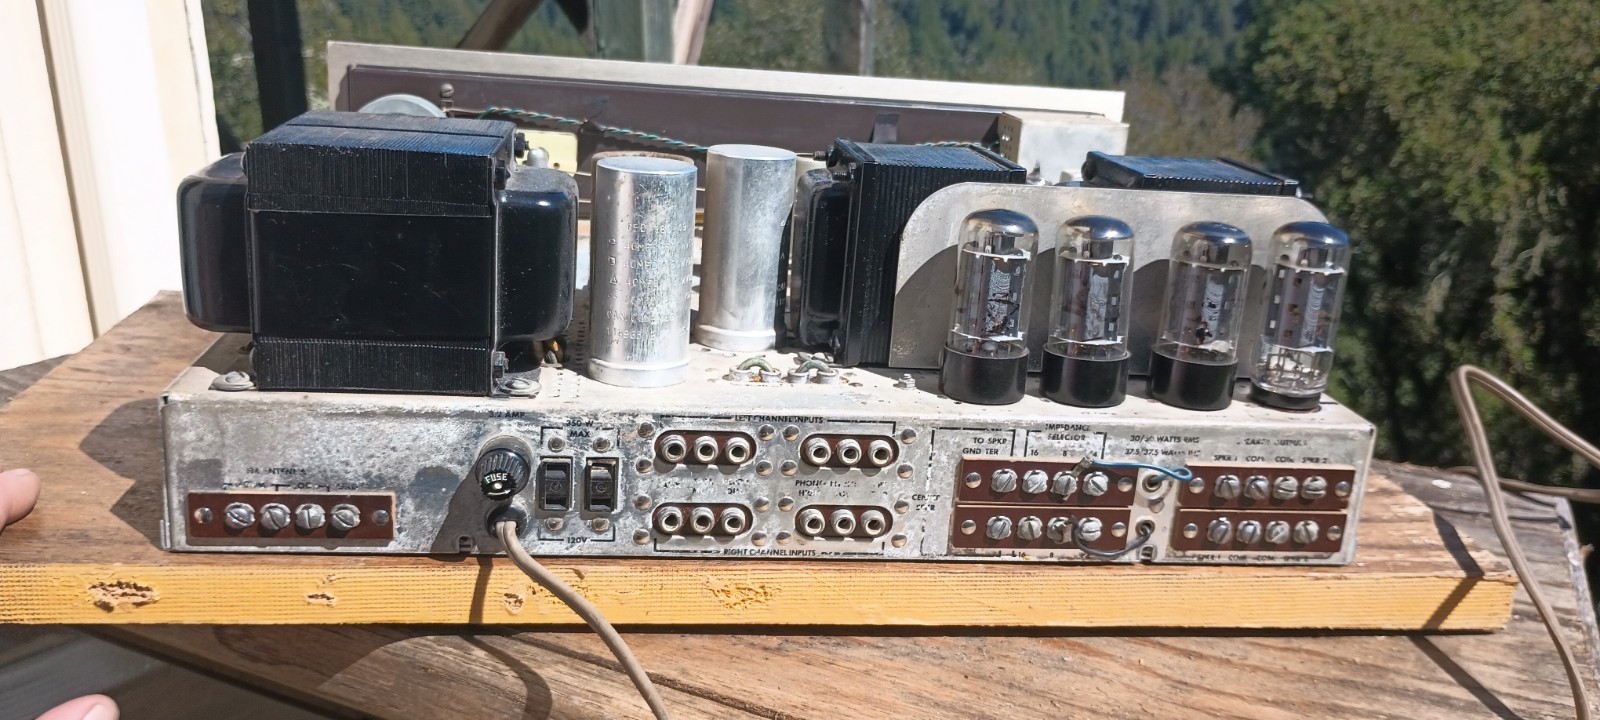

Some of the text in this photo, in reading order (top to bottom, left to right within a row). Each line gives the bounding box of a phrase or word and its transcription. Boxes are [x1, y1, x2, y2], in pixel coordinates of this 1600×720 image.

[484, 473, 508, 484] FUSE
[723, 548, 747, 556] RIGHT
[789, 549, 816, 557] INPUTS
